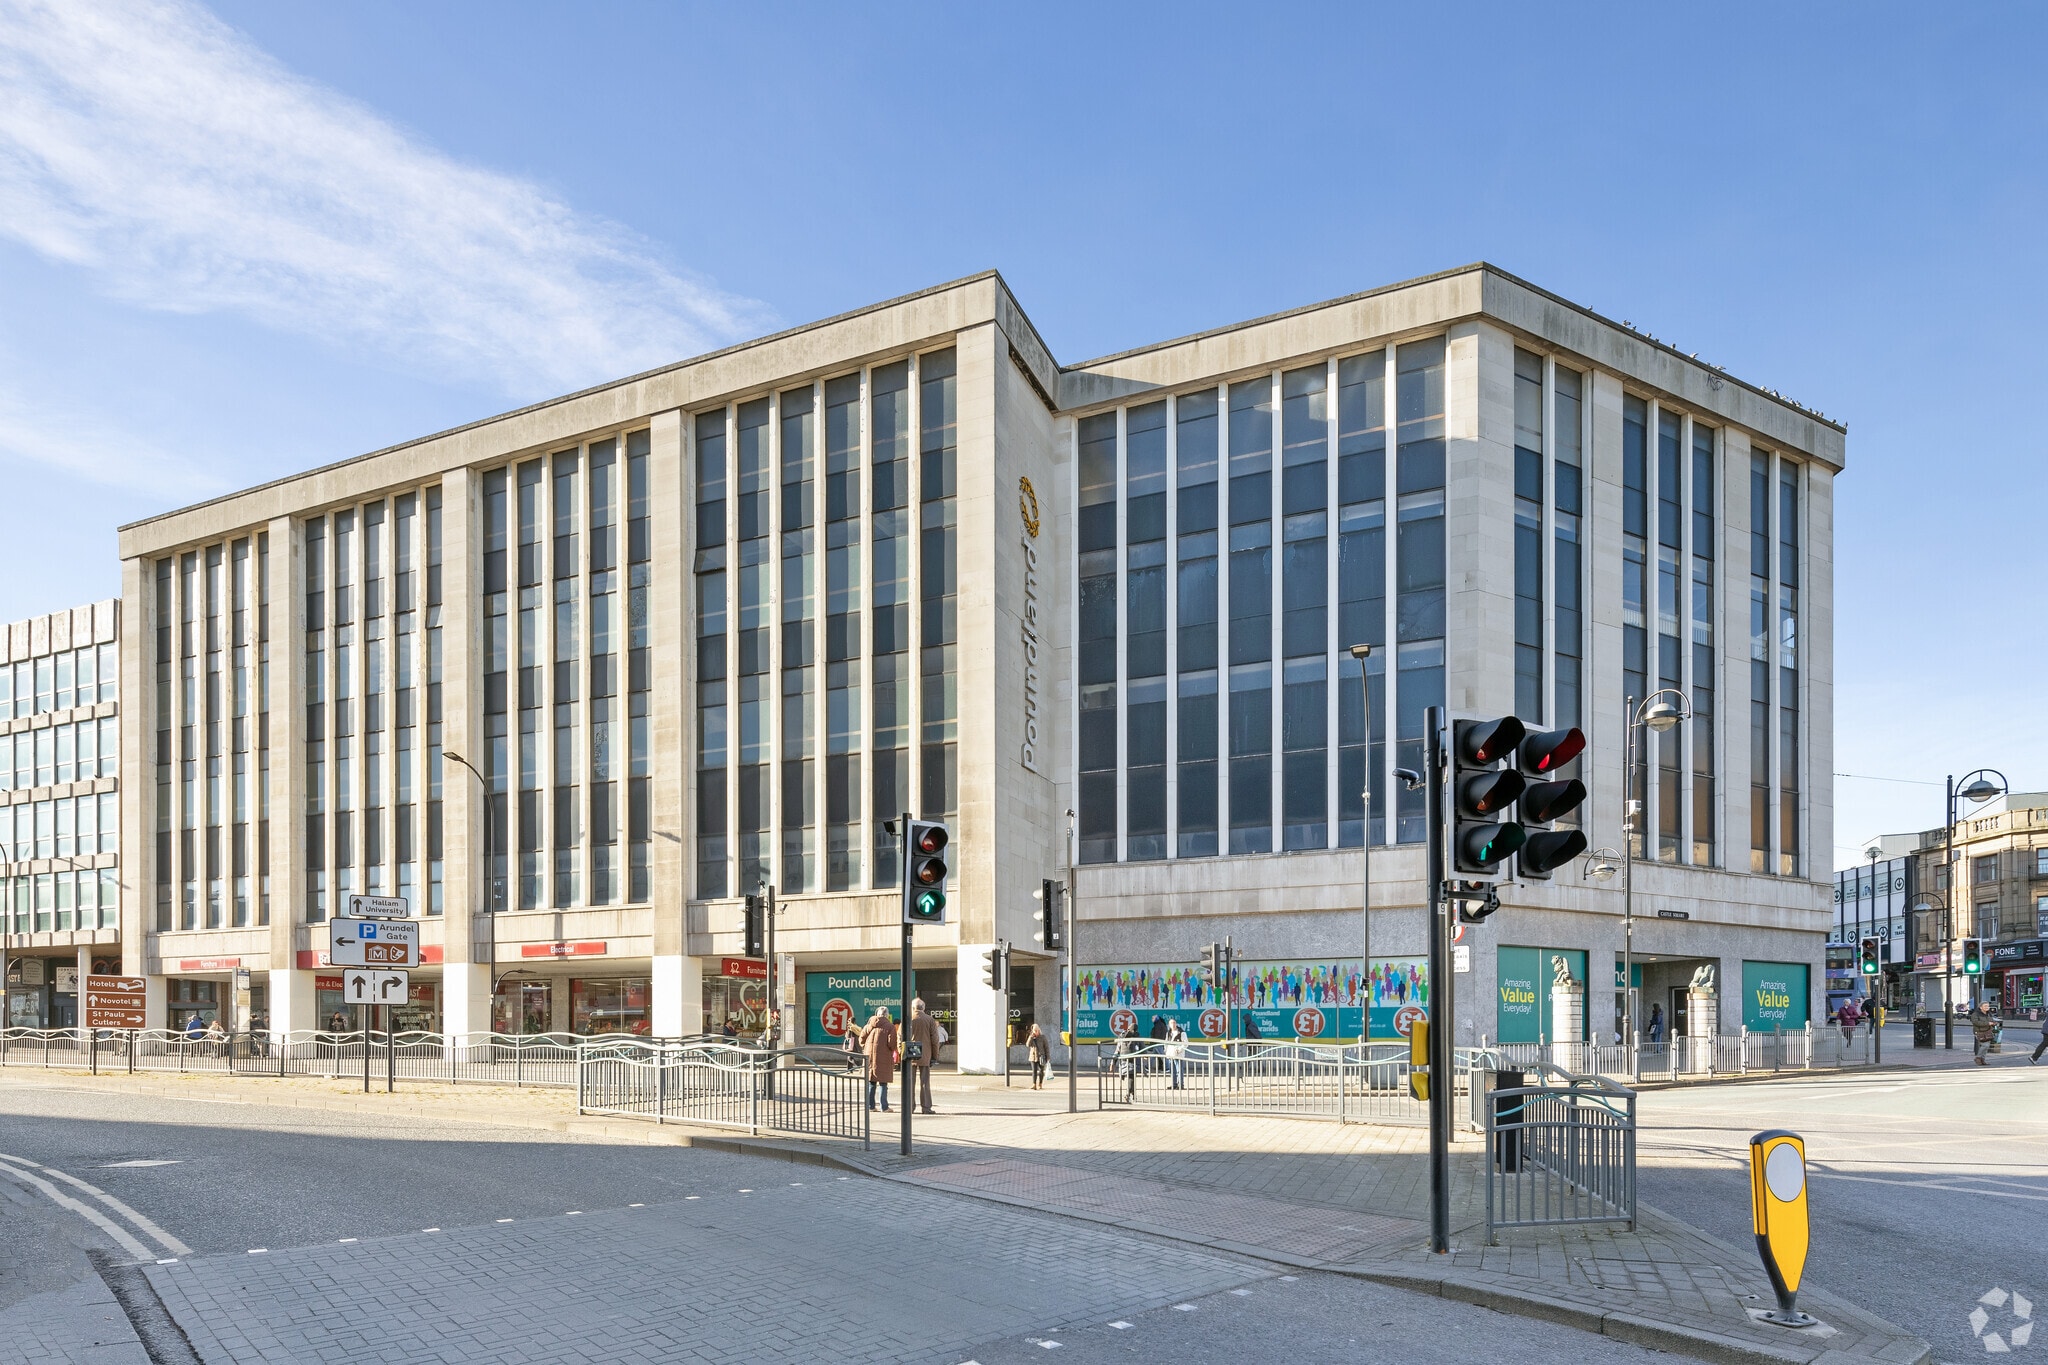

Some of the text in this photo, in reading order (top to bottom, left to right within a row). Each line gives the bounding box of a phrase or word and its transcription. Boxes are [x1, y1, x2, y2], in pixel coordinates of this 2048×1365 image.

[1020, 537, 1039, 774] Poundland
[371, 899, 399, 907] Hallam
[1440, 903, 1446, 913] 9
[365, 906, 404, 915] University
[363, 924, 414, 937] P Arundel
[386, 932, 408, 941] Gate
[550, 945, 575, 954] Electrical
[1994, 947, 2016, 956] FONE
[828, 975, 892, 989] Poundland
[1504, 978, 1532, 989] Amazing
[1760, 980, 1786, 992] Amazing
[100, 997, 132, 1005] Novotel
[1500, 987, 1535, 1003] Value
[1756, 990, 1790, 1008] Value
[1503, 1003, 1532, 1014] Everyday!
[1759, 1008, 1787, 1020] Everyday!
[92, 1018, 121, 1026] Cutlers
[825, 1007, 848, 1030] £1
[1114, 1014, 1134, 1032] £1
[1203, 1013, 1224, 1033] £1
[1298, 1013, 1320, 1033] £1
